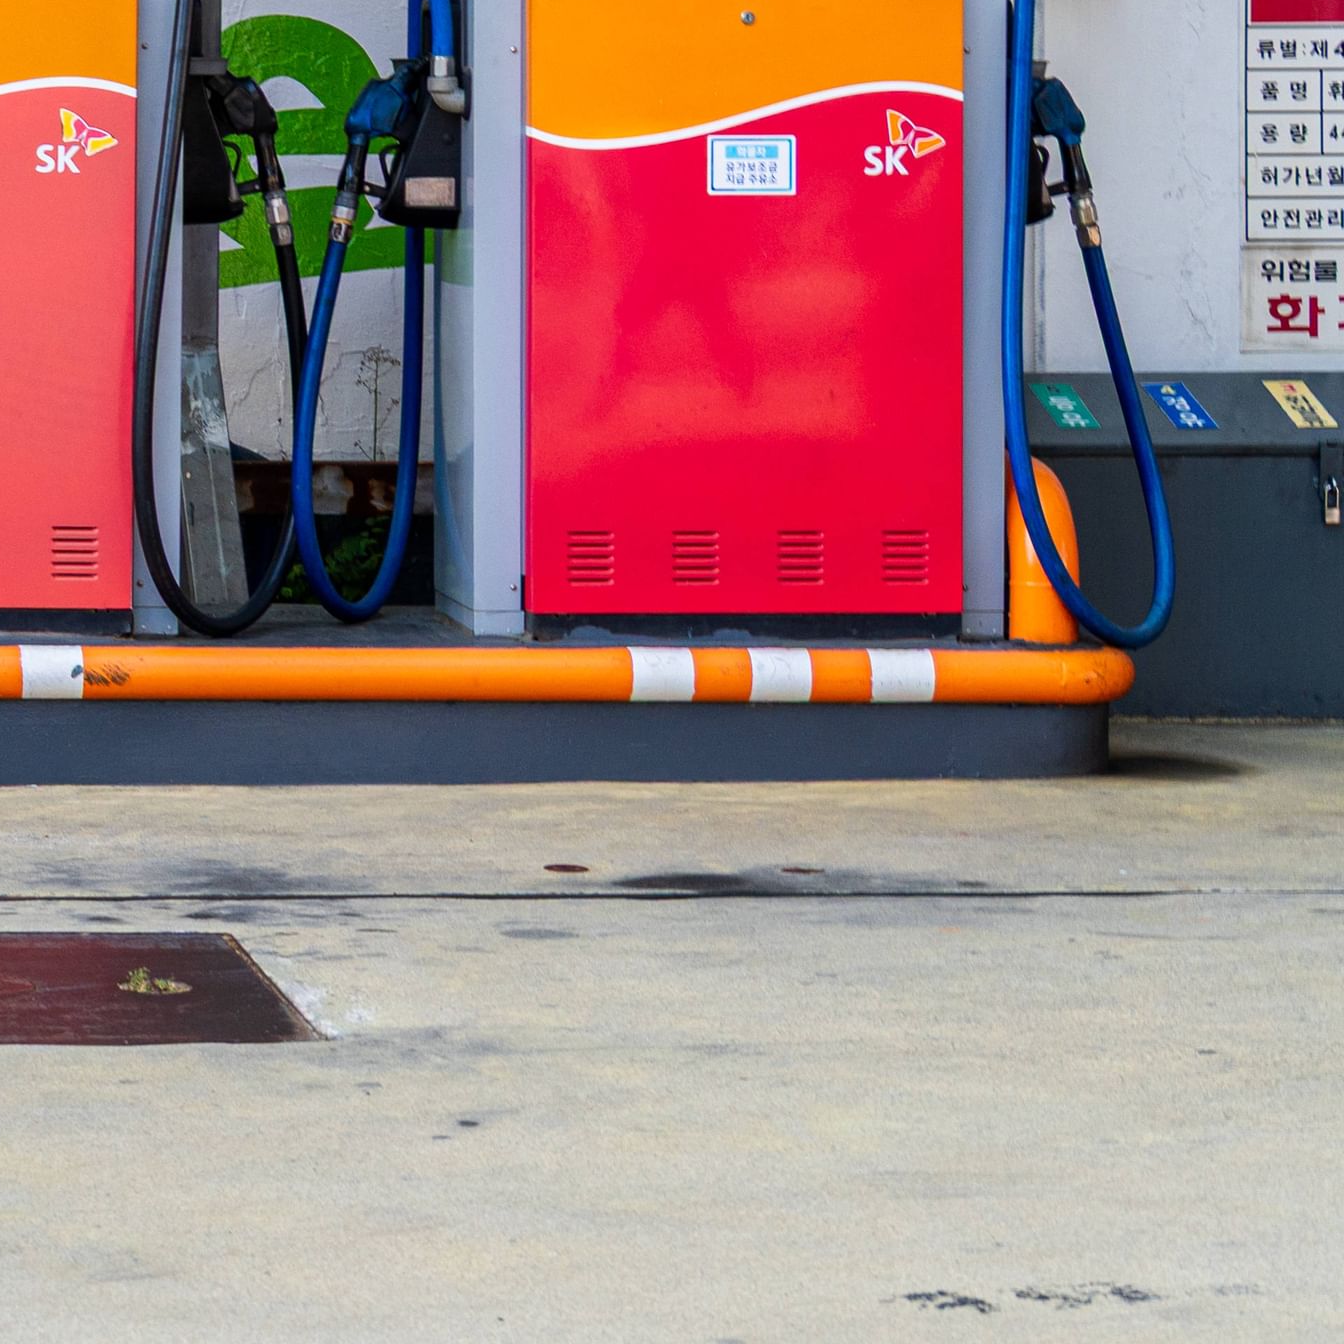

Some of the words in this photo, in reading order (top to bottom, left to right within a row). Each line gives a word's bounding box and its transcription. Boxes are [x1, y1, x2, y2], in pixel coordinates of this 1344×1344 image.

[34, 143, 81, 174] SK
[863, 145, 910, 176] SK
[748, 173, 778, 185] 주유소
[1261, 208, 1344, 229] 안전관리
[1261, 258, 1338, 283] 위험물
[1267, 292, 1344, 338] 화
[1163, 395, 1207, 429] 경유
